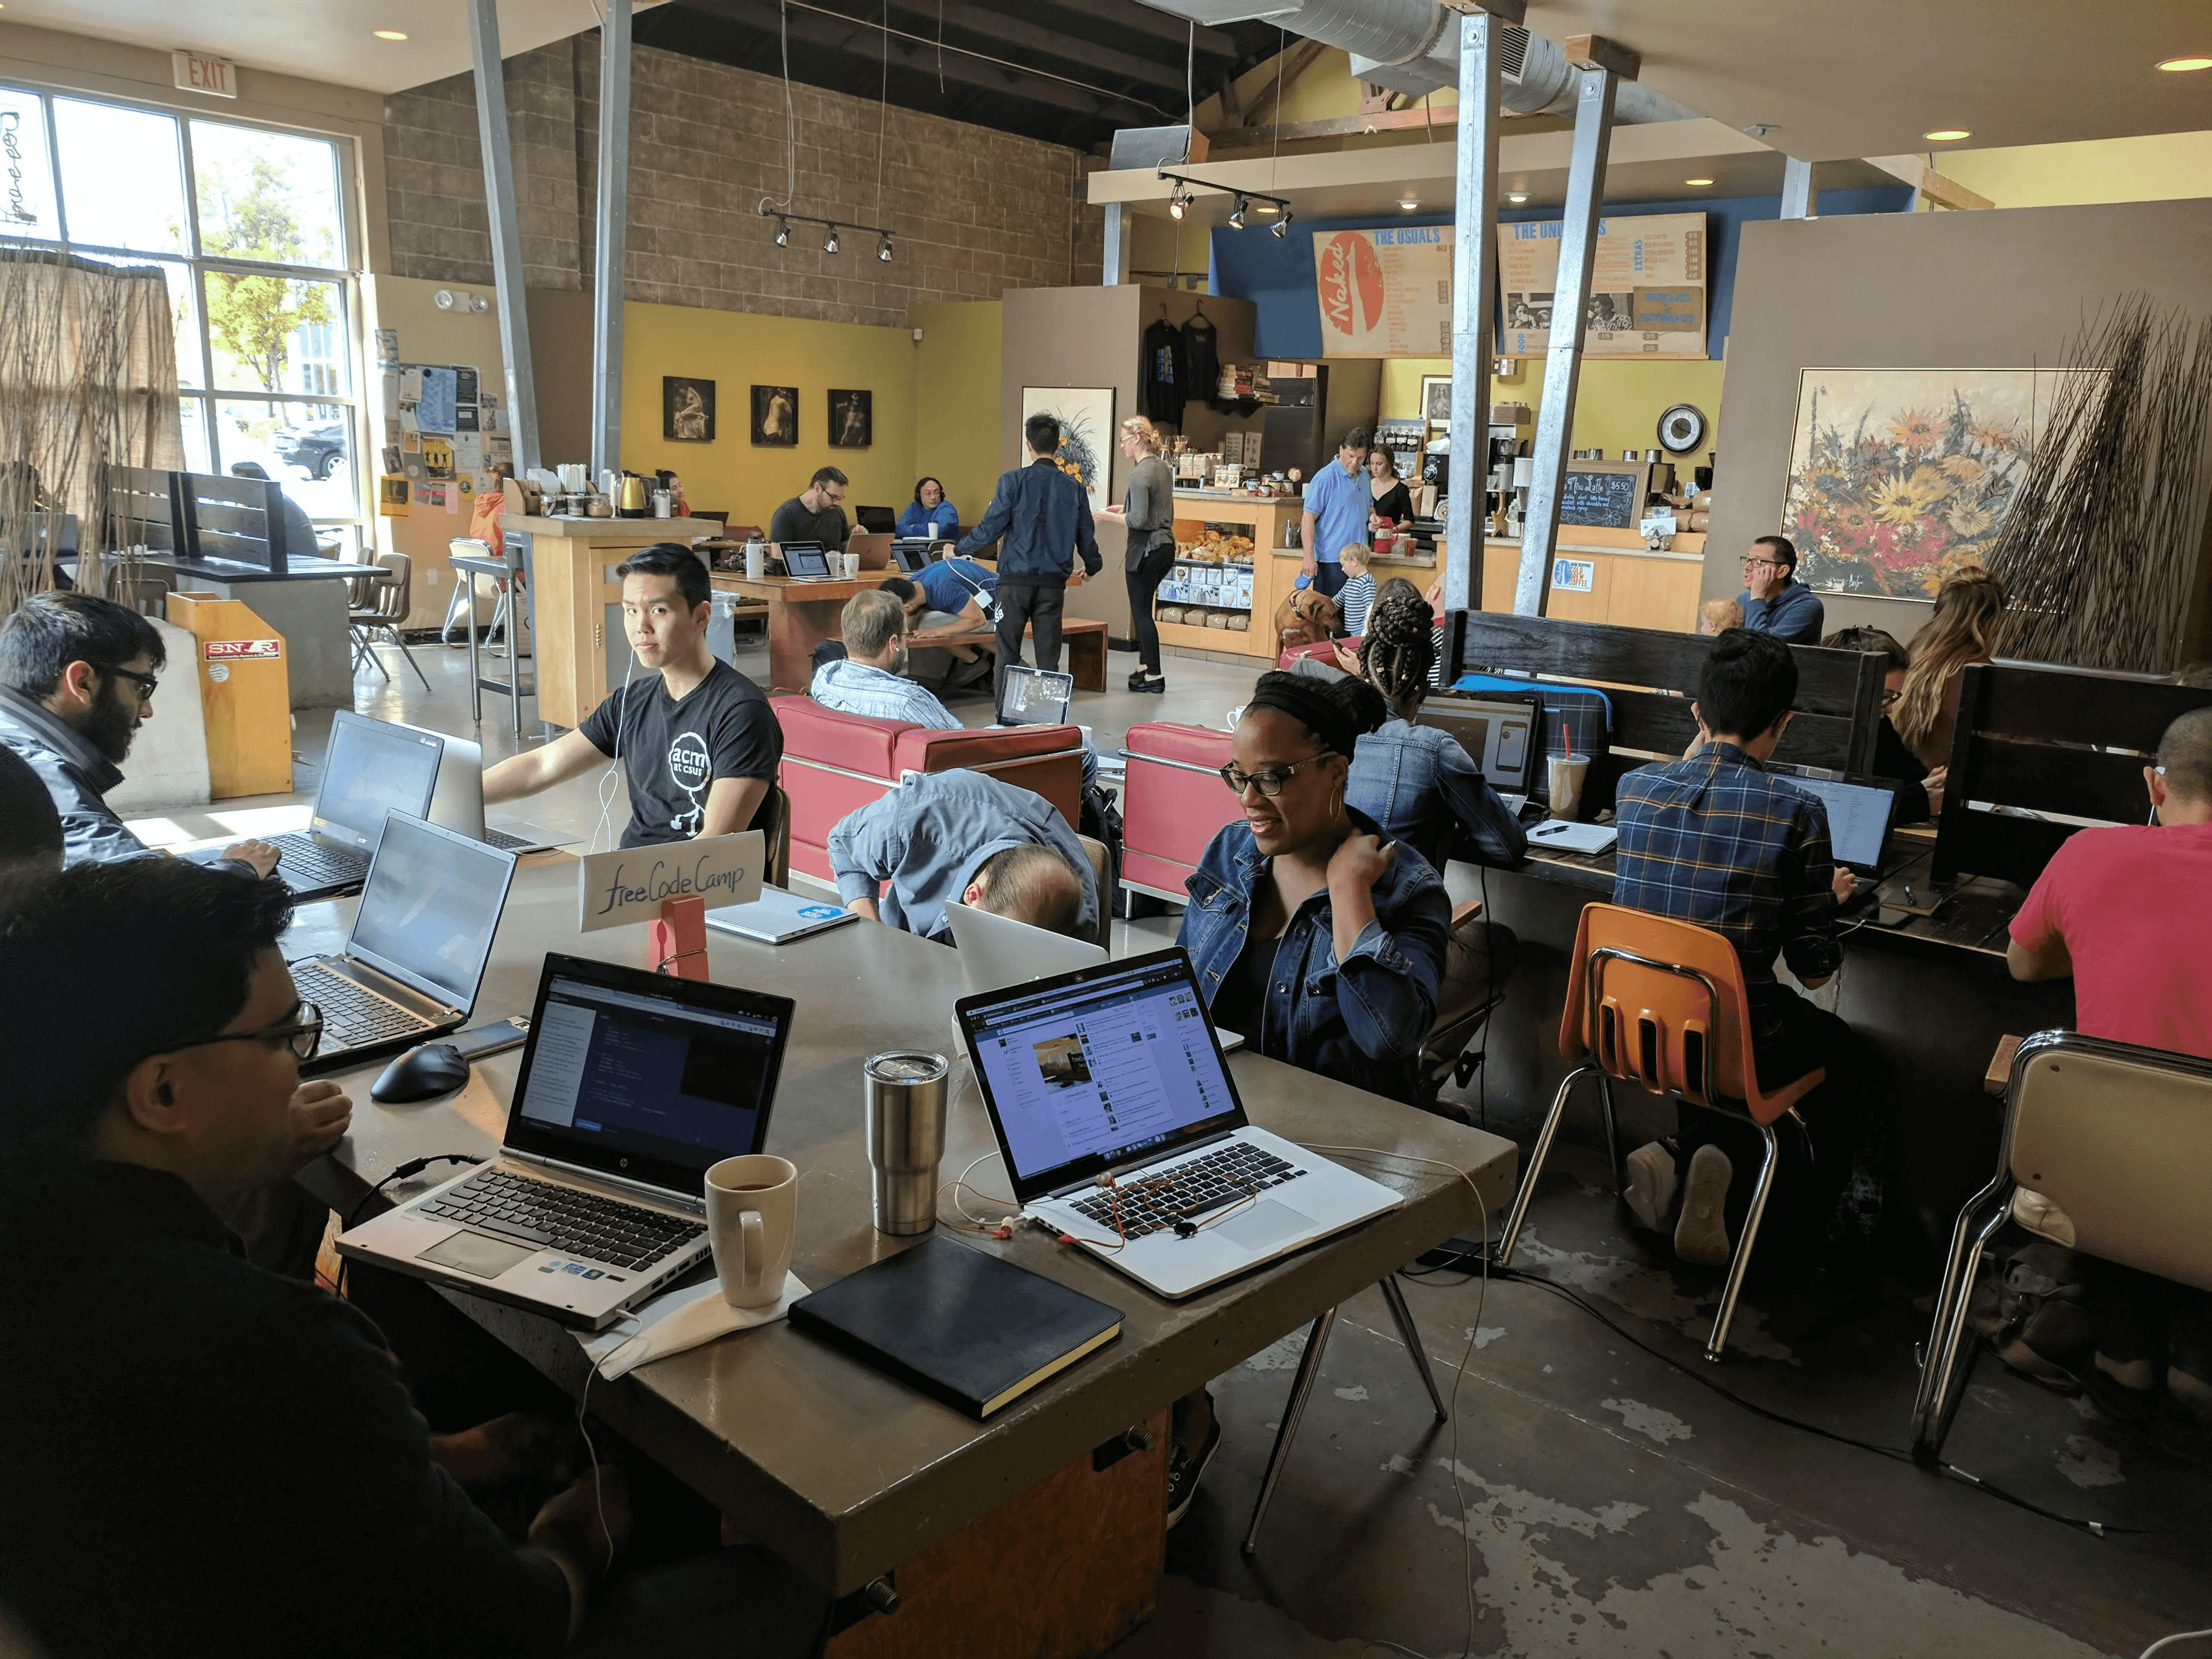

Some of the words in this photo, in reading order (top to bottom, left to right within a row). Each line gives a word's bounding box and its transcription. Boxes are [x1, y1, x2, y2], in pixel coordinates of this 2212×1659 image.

[188, 58, 226, 90] EXIT
[1373, 230, 1395, 245] THE
[1397, 228, 1441, 244] USUALS
[1513, 223, 1537, 239] THE
[1634, 239, 1643, 271] EXTRAS
[1325, 242, 1350, 321] Naked
[1567, 476, 1584, 494] Misu
[1584, 475, 1603, 494] Latte
[672, 748, 705, 768] acm
[673, 763, 682, 772] at
[683, 765, 702, 776] csus
